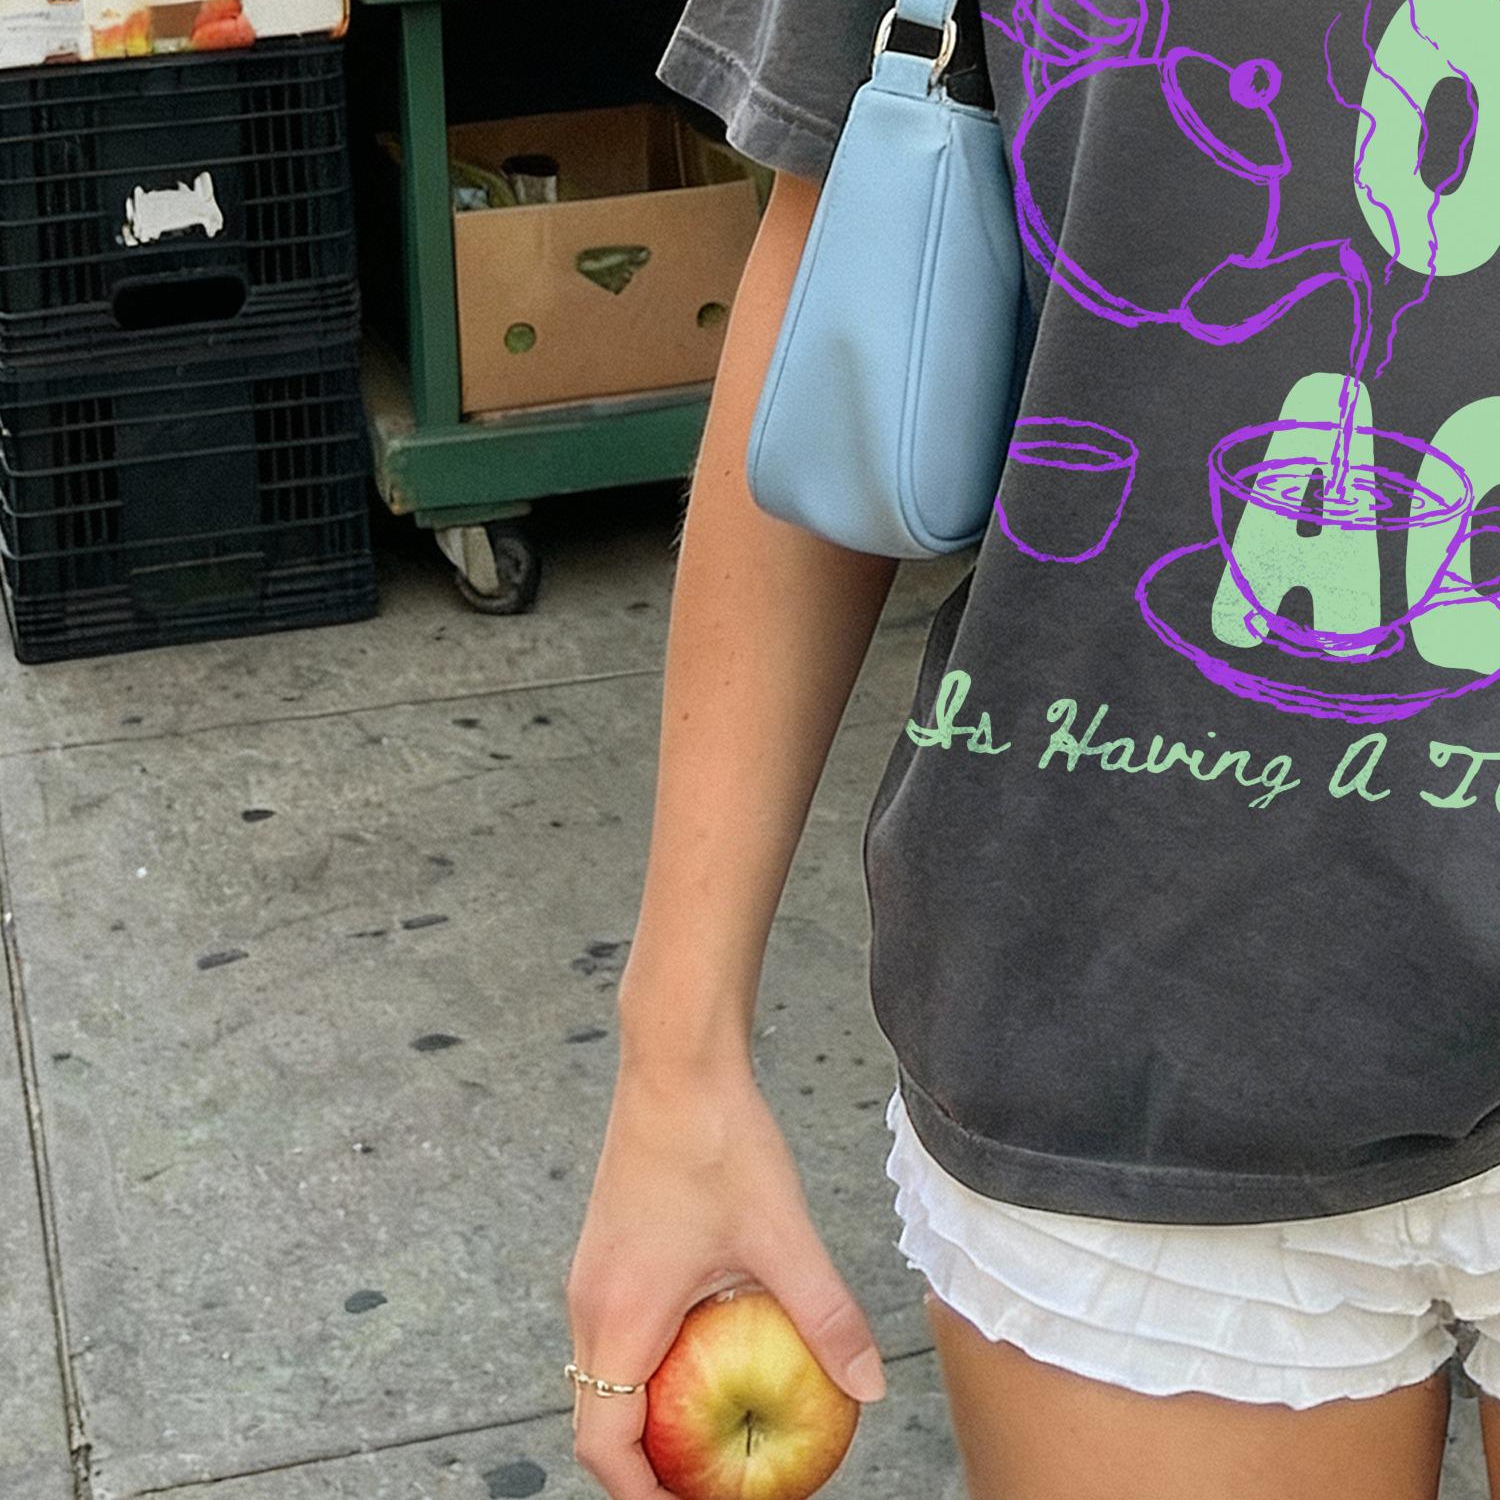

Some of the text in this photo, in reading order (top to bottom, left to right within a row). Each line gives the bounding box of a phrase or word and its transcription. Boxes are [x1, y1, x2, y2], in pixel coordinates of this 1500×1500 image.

[905, 669, 1011, 755] Is
[1038, 698, 1301, 809] Having
[1328, 732, 1391, 802] A
